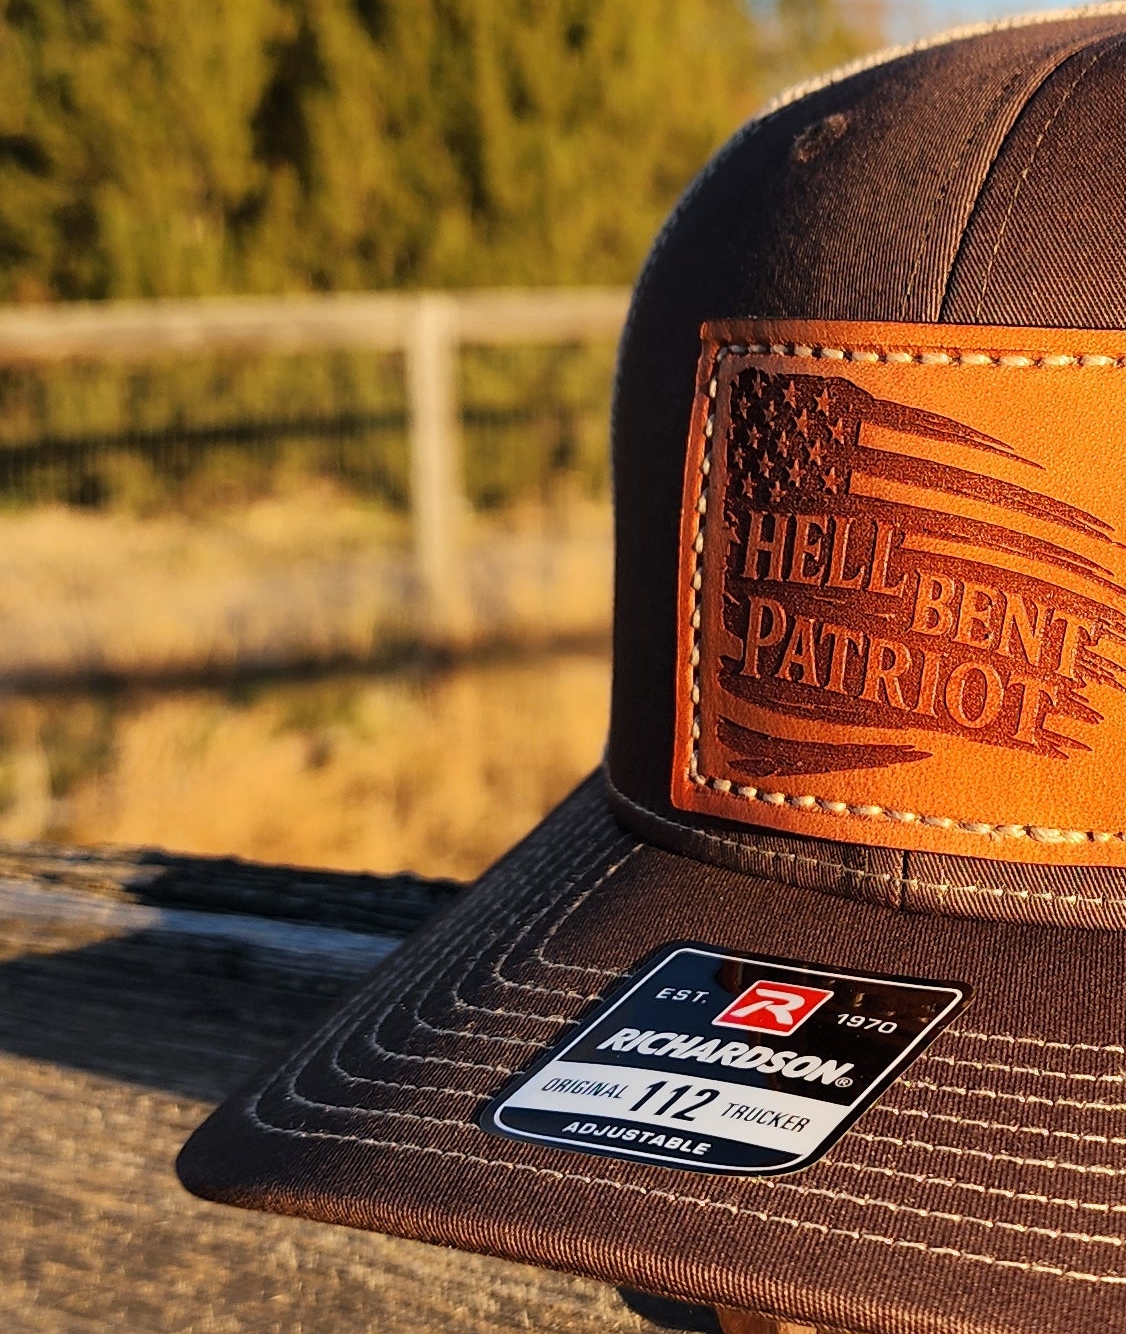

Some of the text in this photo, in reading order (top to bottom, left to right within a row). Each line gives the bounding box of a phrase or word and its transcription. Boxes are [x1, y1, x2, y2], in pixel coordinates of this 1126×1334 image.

[742, 510, 1103, 681] HELL BENT
[740, 594, 1058, 746] PATRIOT
[655, 987, 709, 1004] EST.
[837, 1012, 898, 1034] 1970
[541, 1077, 812, 1134] ORIGINAL 112 TRUCKER
[562, 1121, 711, 1155] ADJUSTABLE
